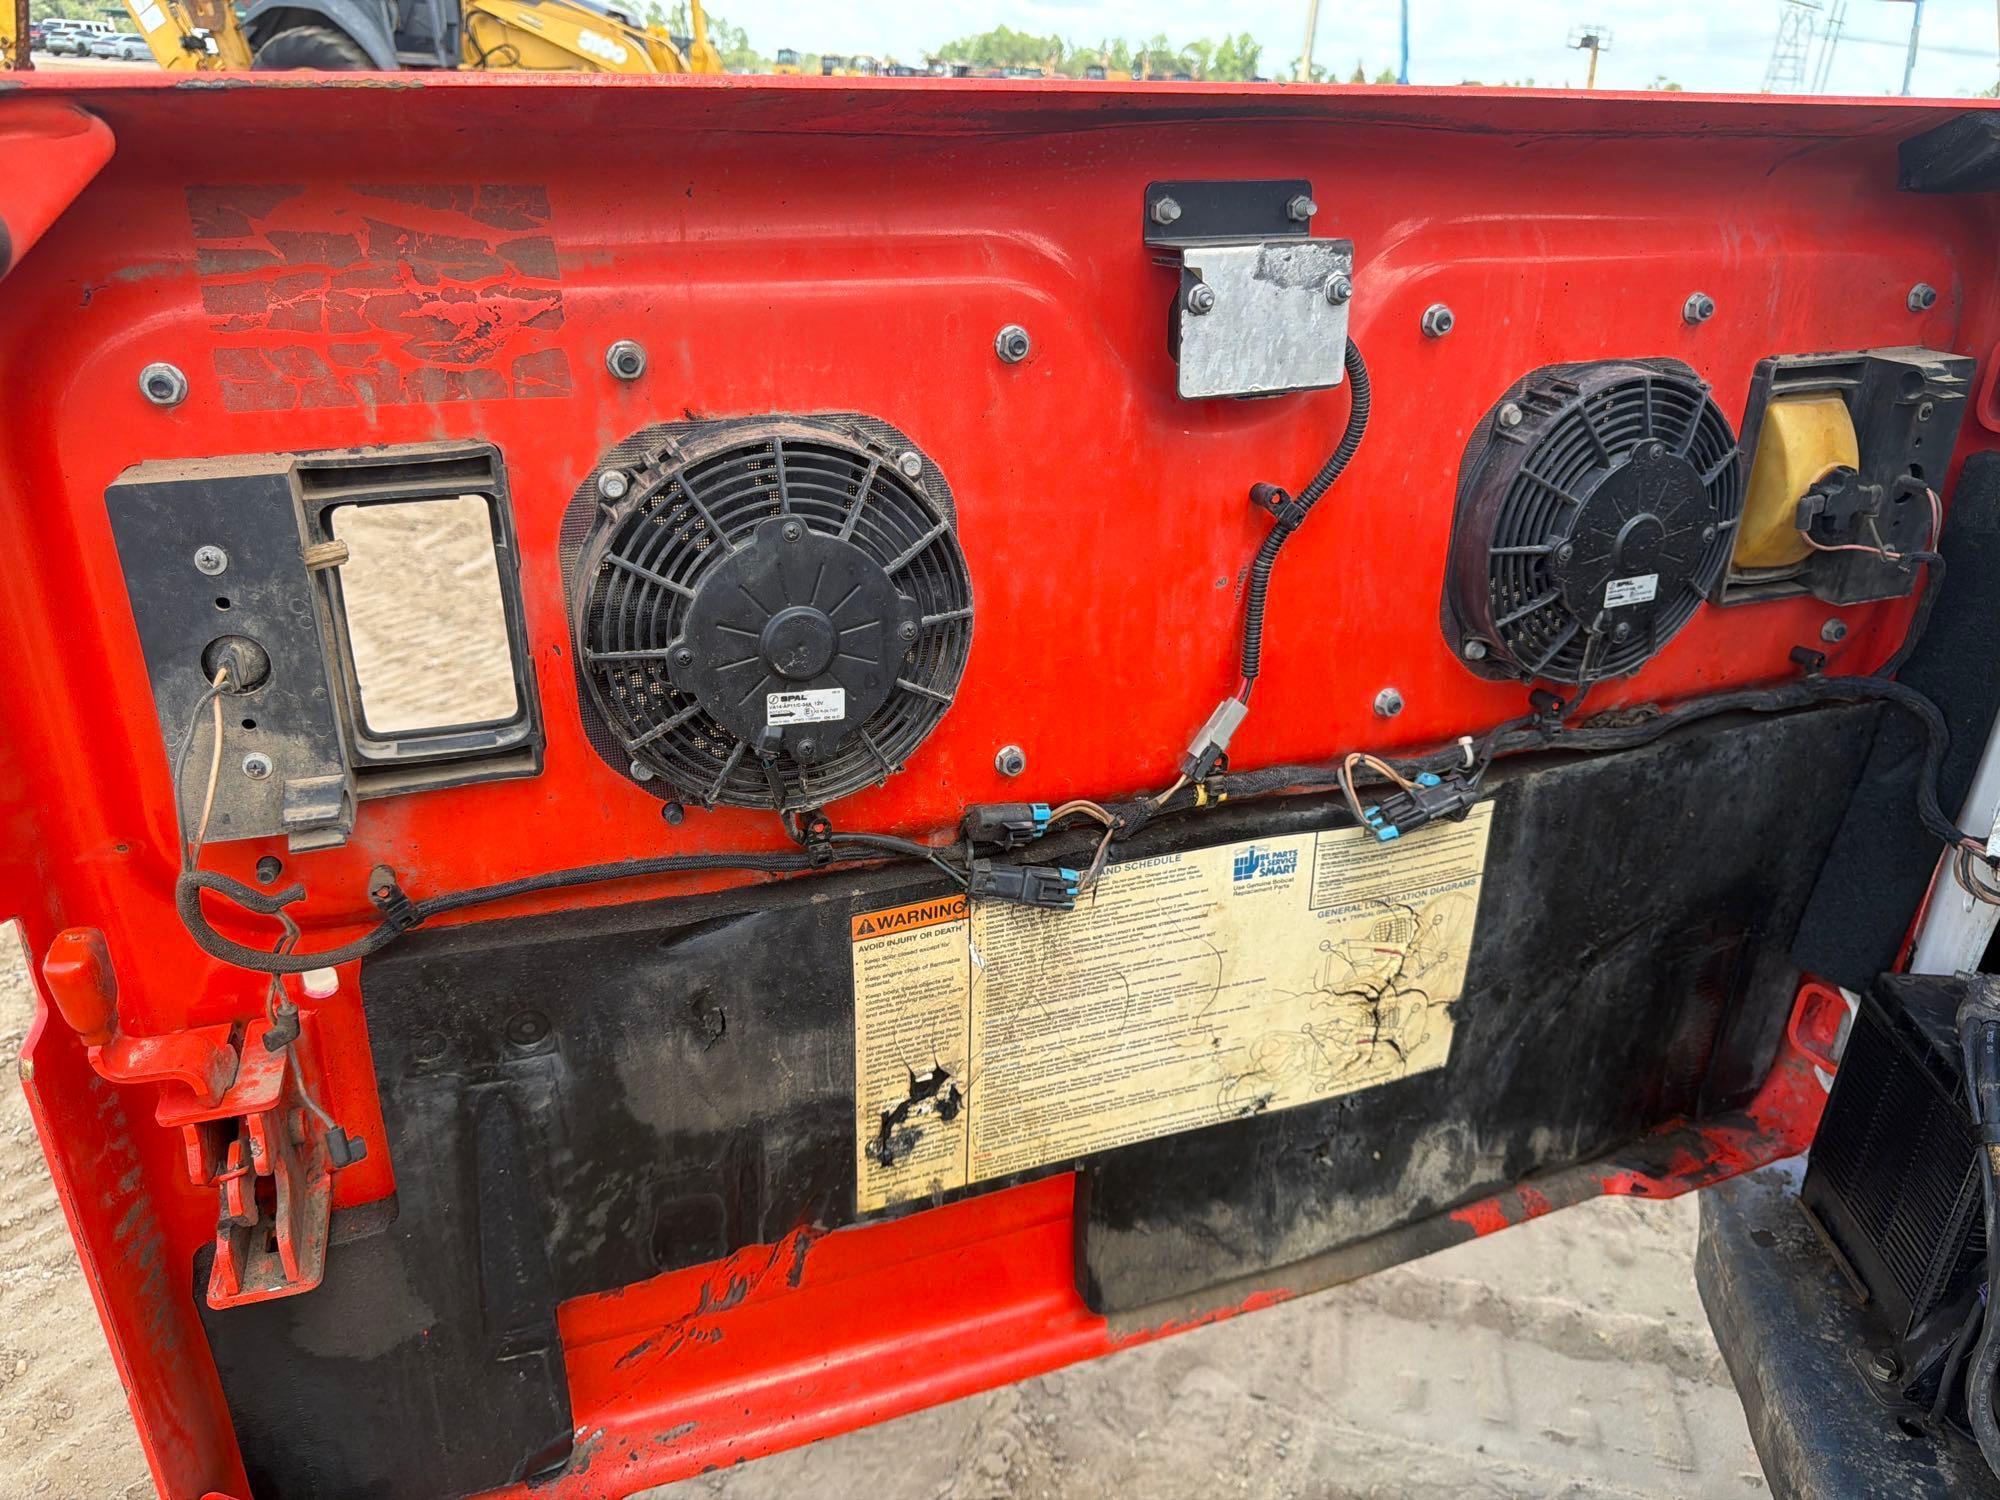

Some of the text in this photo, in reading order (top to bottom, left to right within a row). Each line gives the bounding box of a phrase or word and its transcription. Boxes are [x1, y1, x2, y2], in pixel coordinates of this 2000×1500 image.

[1267, 856, 1297, 867] SERVICE
[1272, 849, 1298, 860] PARTS
[1099, 855, 1182, 877] AND SCHEDULE
[1259, 863, 1297, 879] SMART
[1247, 880, 1271, 890] Genuine
[1273, 876, 1294, 885] Bobcat
[1233, 885, 1272, 898] Replacement
[1318, 878, 1476, 919] GENERAL LUBRICATION DIAGRAMS
[876, 901, 965, 930] WARNING
[859, 942, 884, 952] AVOID
[887, 935, 917, 947] INJURY
[935, 926, 962, 936] DEATH
[865, 957, 880, 965] Keep
[865, 975, 881, 983] Keep
[991, 1162, 1030, 1176] OPERATION
[1039, 1147, 1088, 1164] MAINTENANCE
[1091, 1140, 1118, 1151] MANUAL
